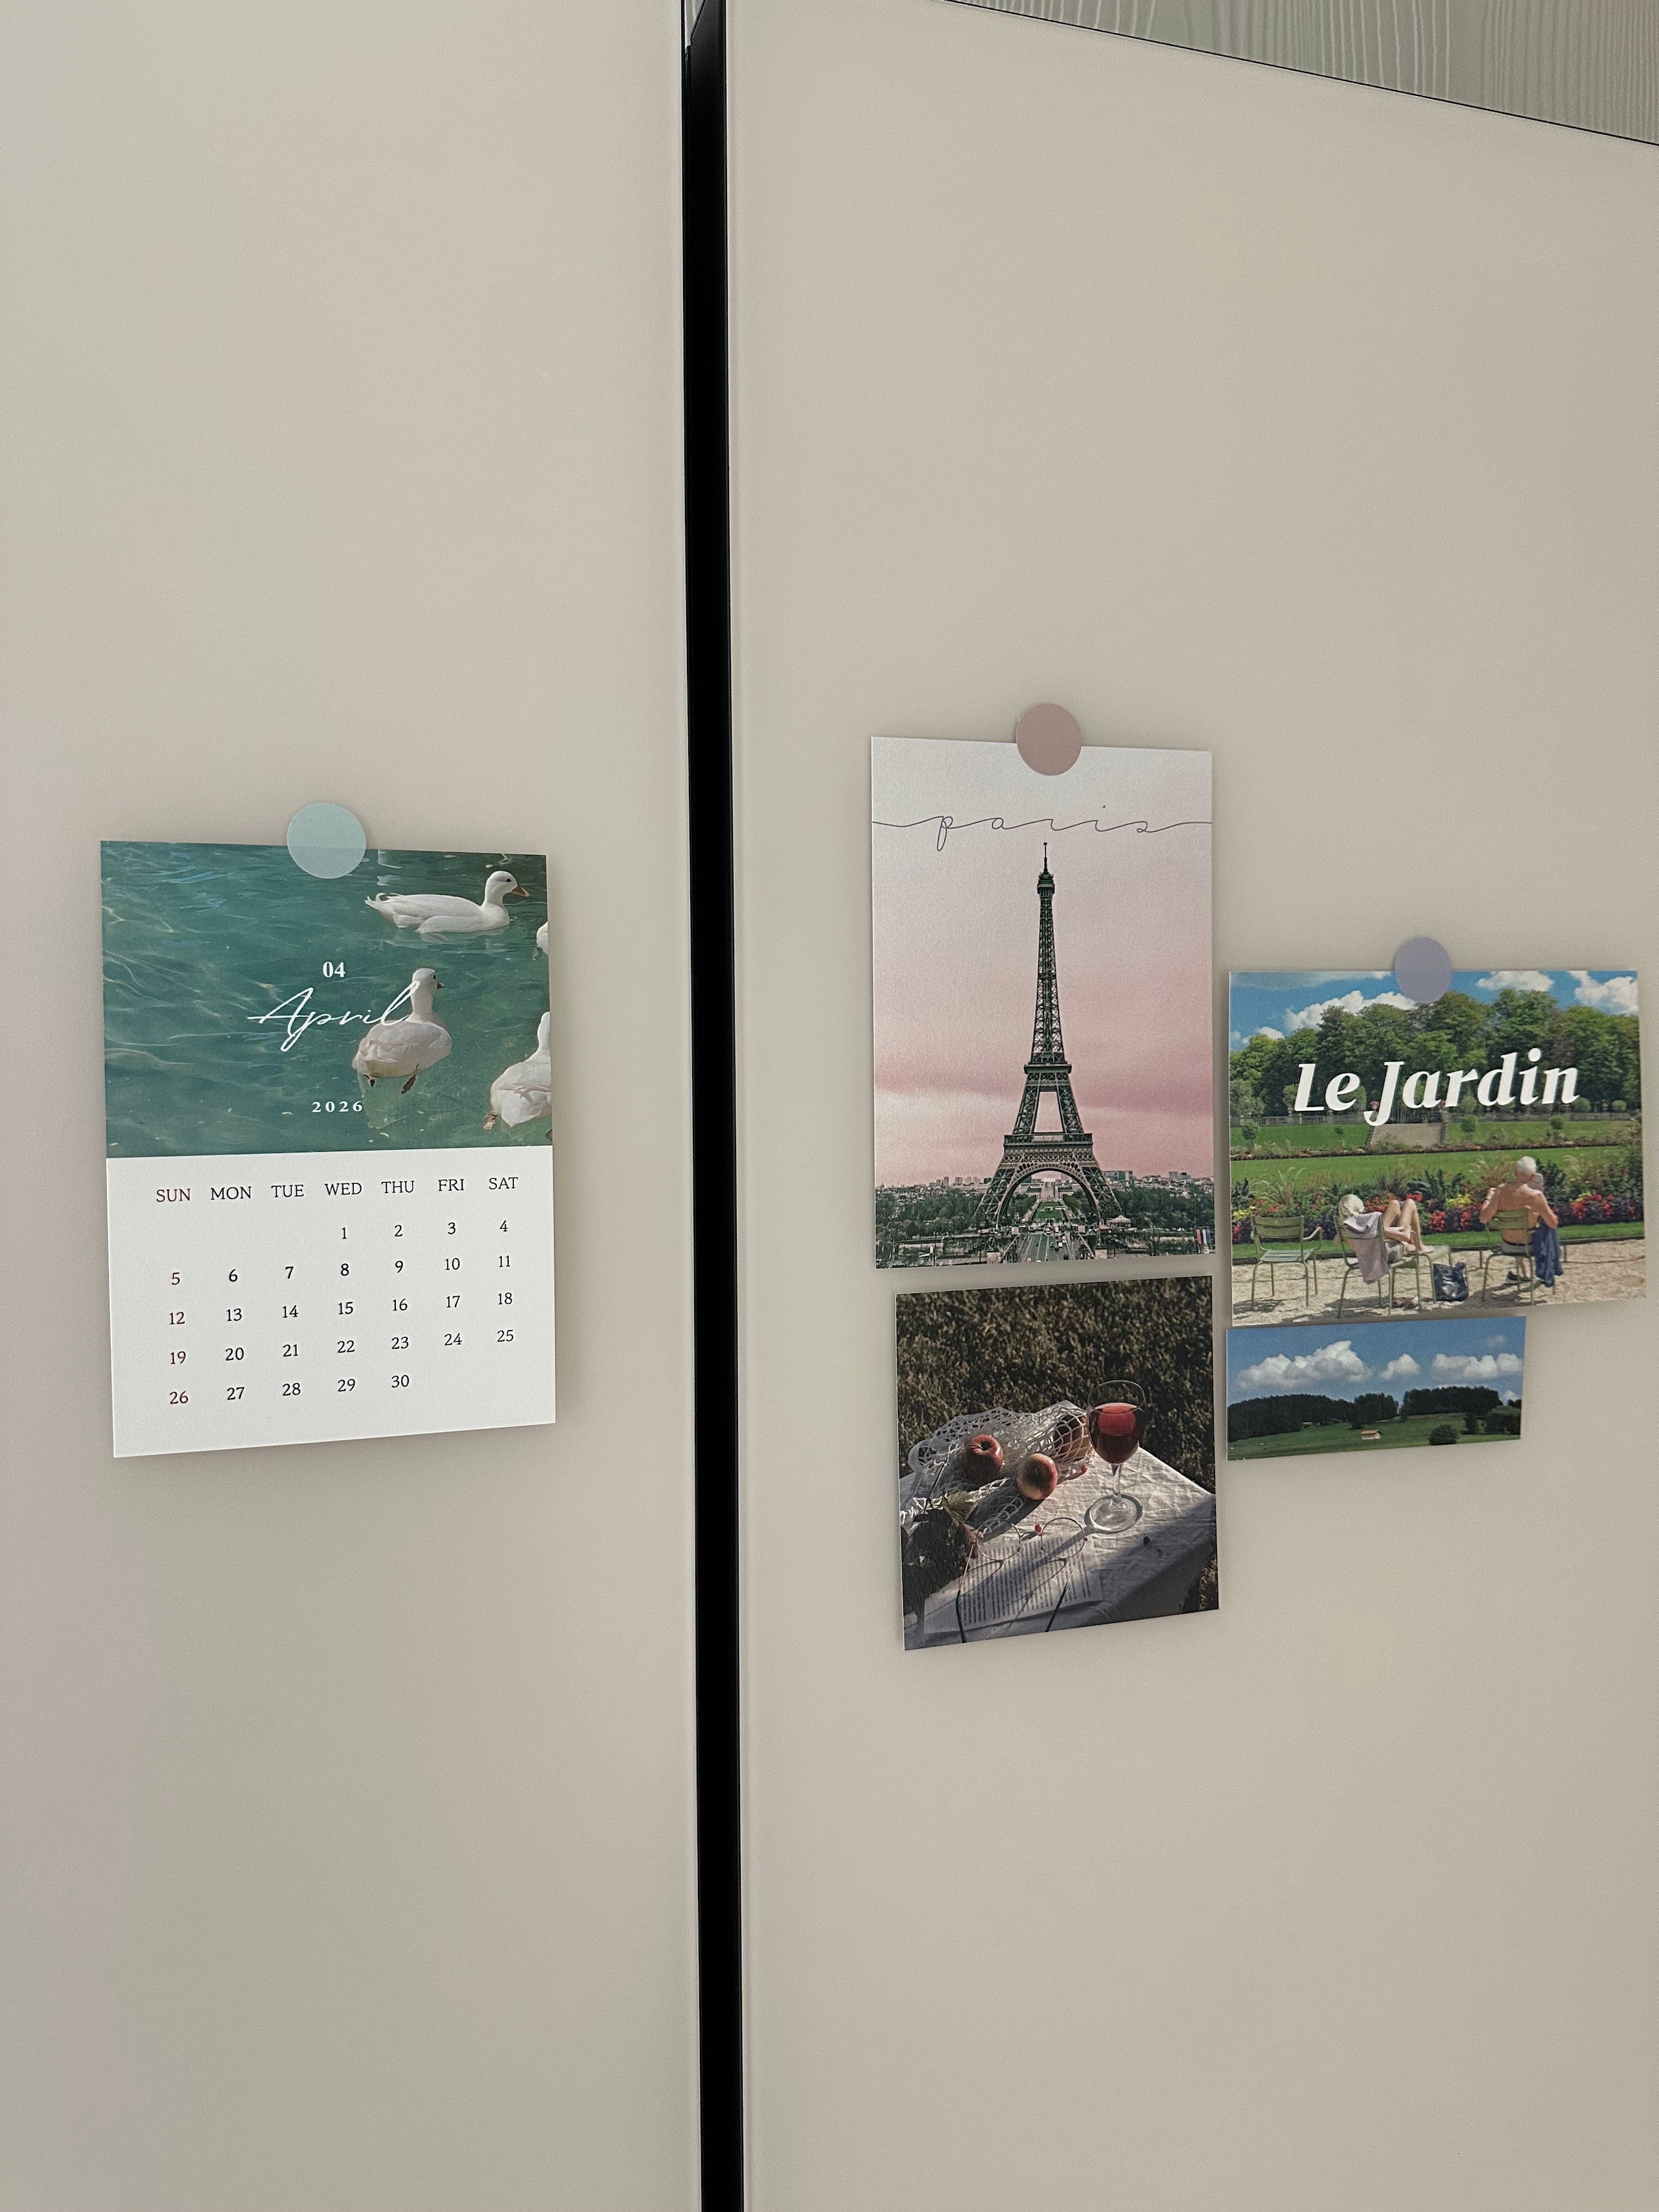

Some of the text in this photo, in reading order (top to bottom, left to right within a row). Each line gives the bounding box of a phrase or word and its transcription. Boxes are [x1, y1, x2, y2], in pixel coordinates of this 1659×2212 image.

[909, 804, 1166, 852] paris
[323, 962, 345, 978] 04
[248, 981, 421, 1053] April
[1293, 1047, 1581, 1126] Le Jardin
[312, 1100, 362, 1113] 2026
[156, 1176, 519, 1203] SUN MON TUE WED THU FRI SAT
[342, 1220, 509, 1240] 1 2 3 4
[171, 1255, 511, 1286] 5 6 7 8 9 10 11
[169, 1292, 513, 1325] 12 13 14 15 16 17 18
[170, 1329, 514, 1365] 19 20 21 22 23 24 25
[169, 1374, 410, 1405] 26 27 28 29 30
